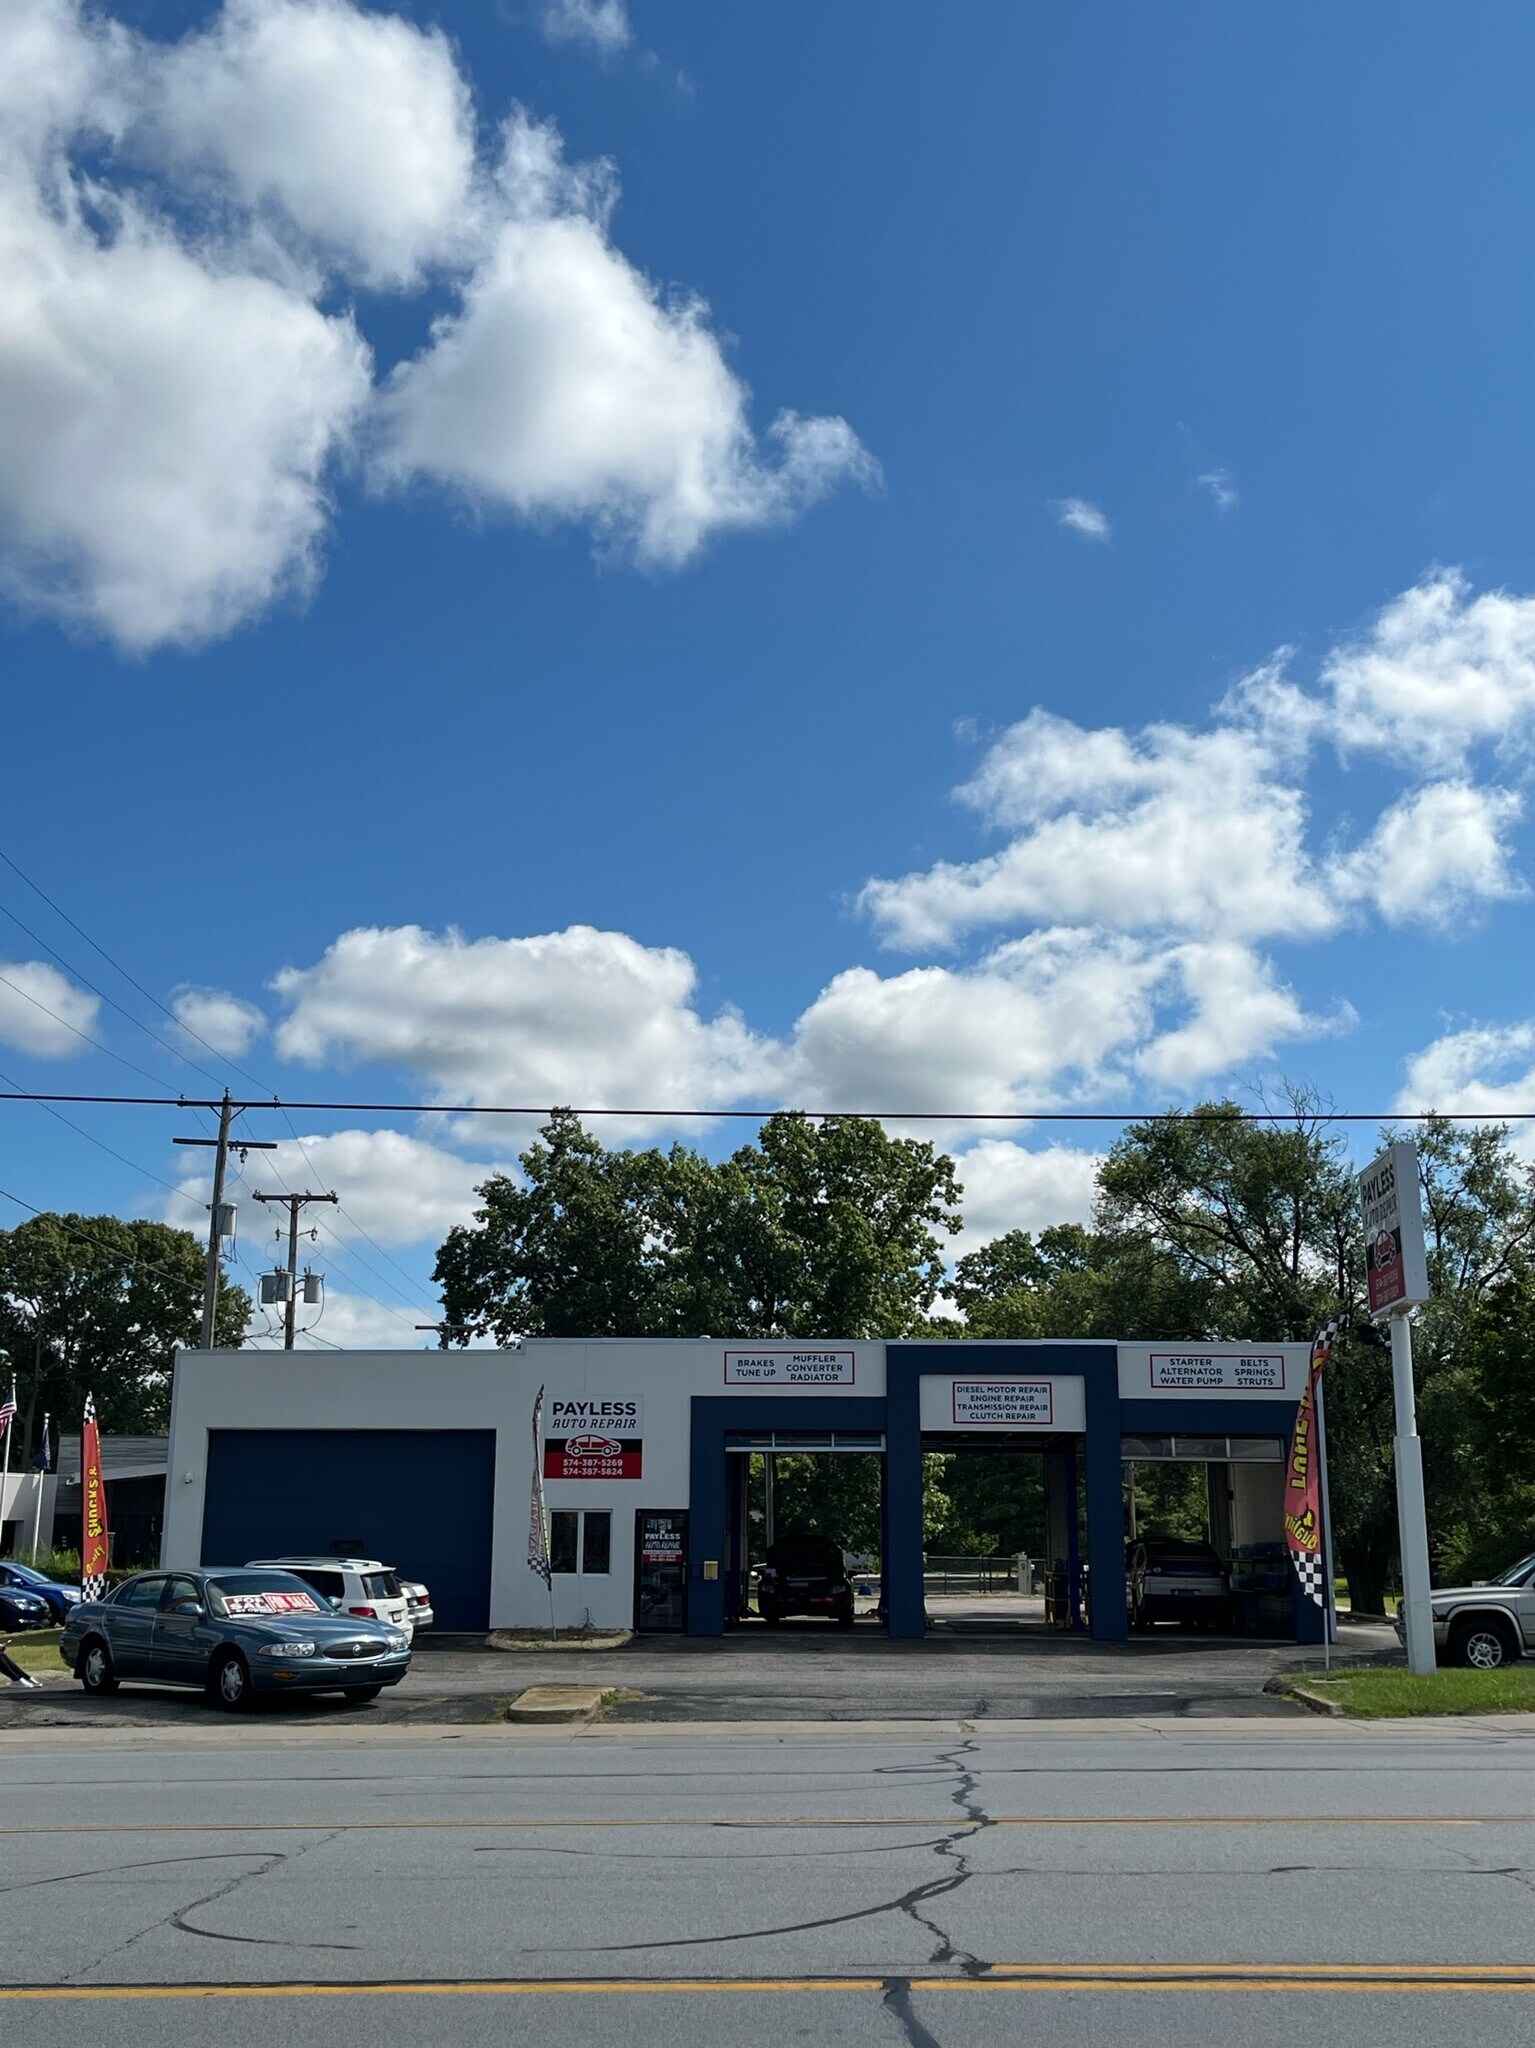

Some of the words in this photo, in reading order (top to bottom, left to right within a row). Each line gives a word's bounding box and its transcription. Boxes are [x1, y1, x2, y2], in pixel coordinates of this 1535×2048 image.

[1362, 1164, 1396, 1208] PAYLESS
[737, 1359, 775, 1367] BRAKES
[1169, 1358, 1212, 1366] STARTER
[1240, 1359, 1269, 1367] BELTS
[786, 1364, 843, 1372] CONVERTER
[1160, 1367, 1223, 1375] ALTERNATOR
[1234, 1368, 1276, 1376] SPRINGS
[736, 1369, 760, 1377] TUNE
[790, 1373, 839, 1381] RADIATOR
[1196, 1377, 1223, 1385] PUMP
[552, 1402, 637, 1416] PAYLESS
[957, 1403, 1017, 1411] TRANSMISSION
[552, 1418, 587, 1429] AUTO
[590, 1418, 637, 1429] REPAIR
[562, 1459, 623, 1467] 574-387-5269
[562, 1467, 623, 1476] 574-387-5824
[230, 1602, 270, 1610] SAL
[267, 1595, 290, 1609] FOR
[286, 1595, 313, 1608] SALE
